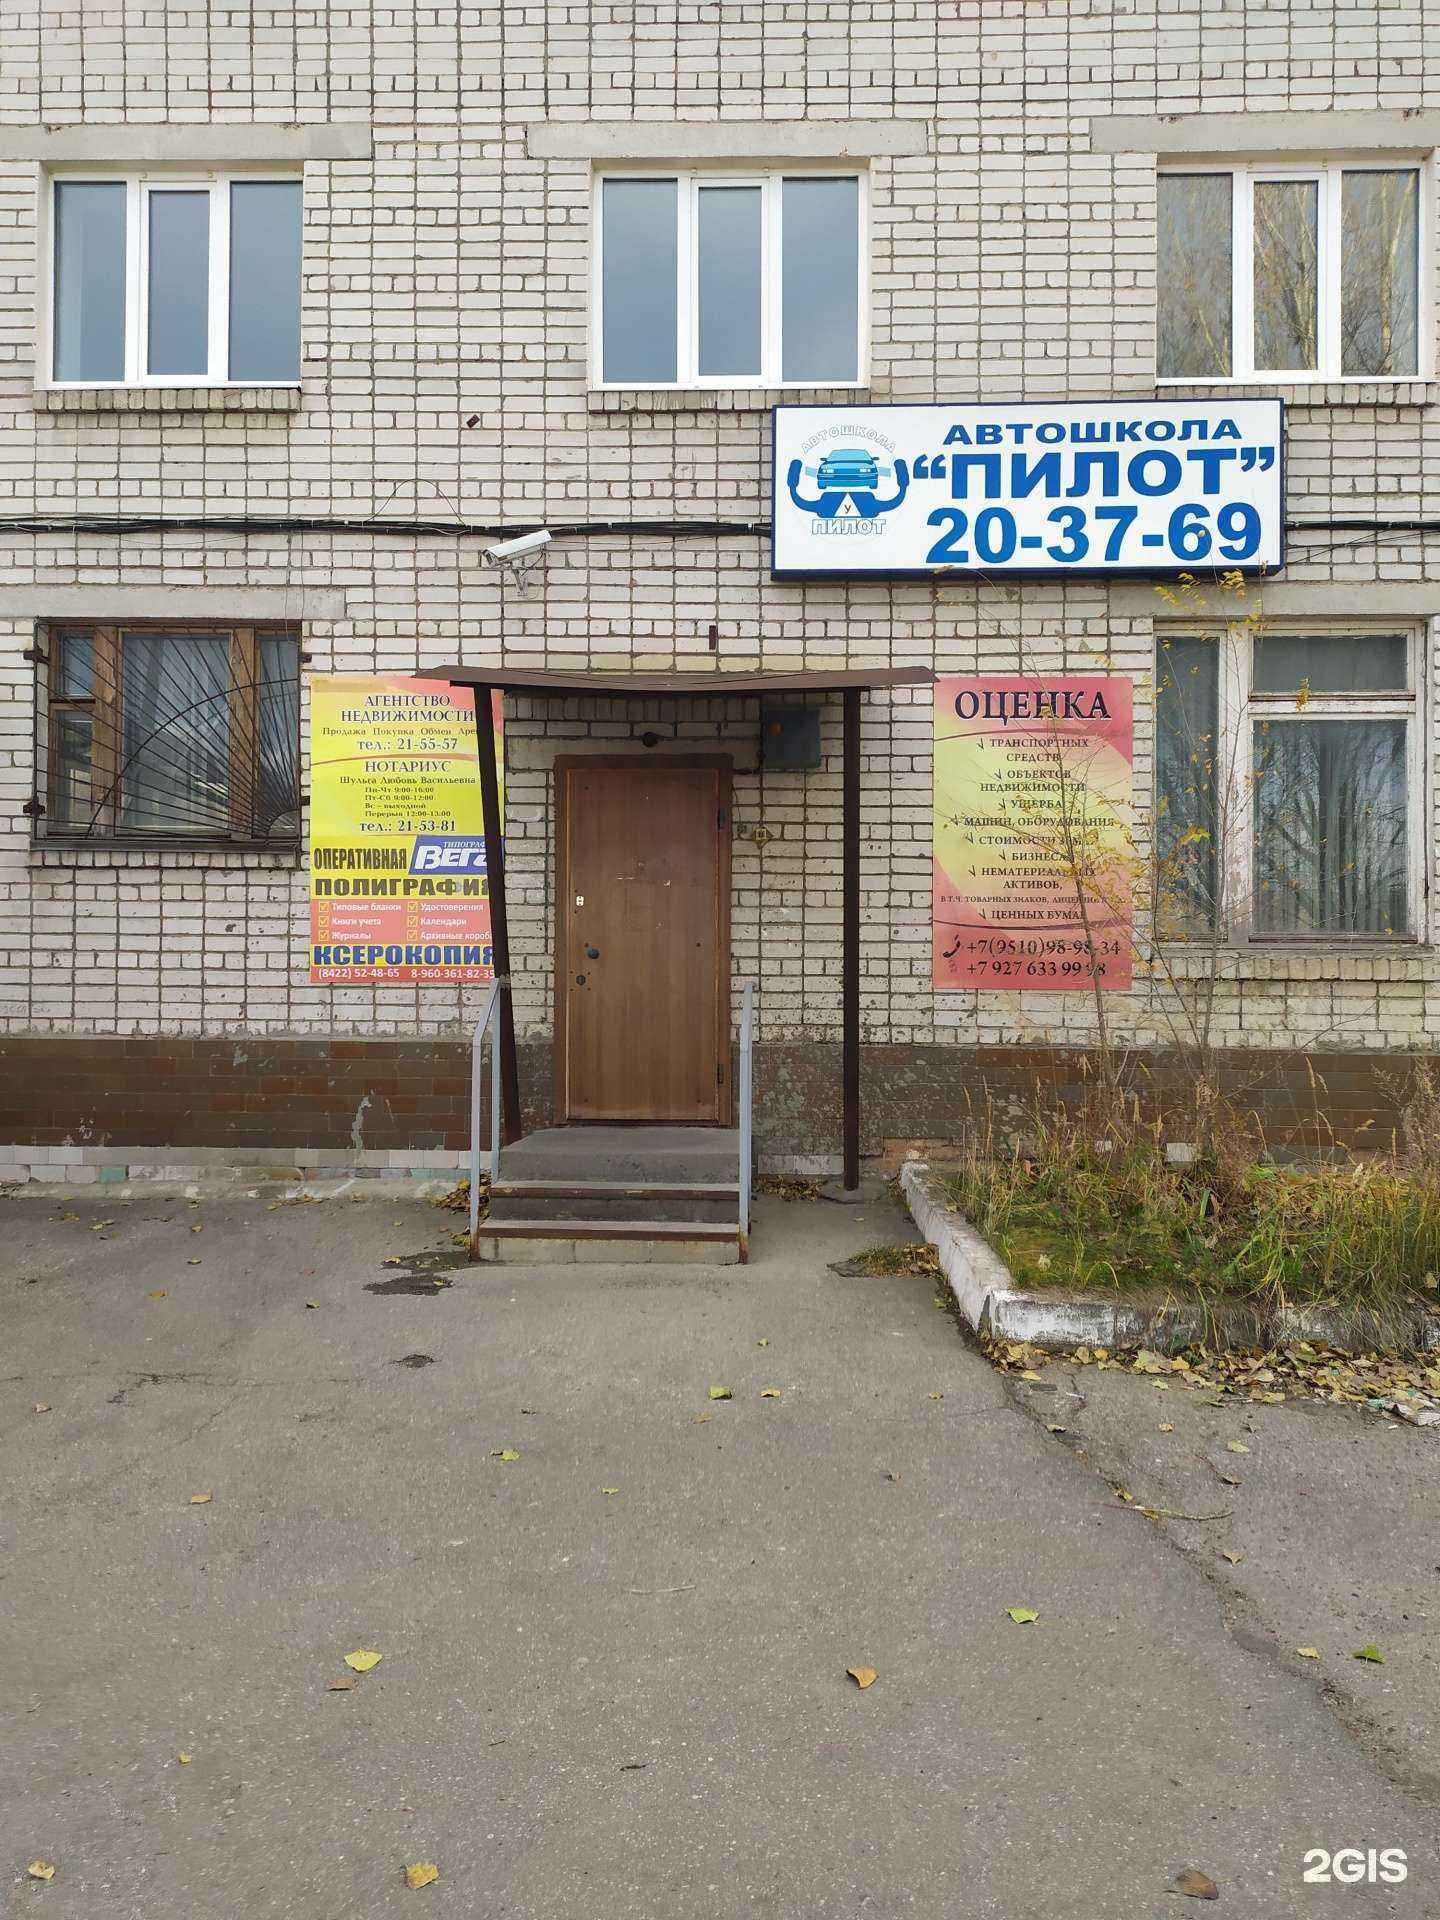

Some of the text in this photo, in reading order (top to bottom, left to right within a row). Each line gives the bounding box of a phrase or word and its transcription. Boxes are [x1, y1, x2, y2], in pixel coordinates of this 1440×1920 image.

[943, 418, 1242, 446] АВТОШКОЛА
[801, 424, 896, 454] АВТОШКОЛА
[811, 519, 887, 535] ПИЛОТ
[925, 501, 1262, 564] 20-37-69
[365, 695, 451, 707] АГЕНТСТВО
[955, 690, 1112, 726] ОЦЕНКА
[341, 710, 474, 724] НЕДВИЖИМОСТИ
[322, 727, 366, 736] Продажа
[373, 727, 414, 737] Покупка
[420, 727, 451, 736] Обмен
[397, 737, 458, 751] 21-55-57
[989, 738, 1089, 748] ТРАНСПОРТНЫХ
[1006, 753, 1061, 763] СРЕДСТВ
[365, 761, 452, 773] НОТАРИУС
[1007, 770, 1071, 779] ОБЪЕКТОВ
[398, 820, 457, 832] 21-53-81
[314, 848, 407, 870] ОПЕРАТИВНАЯ
[332, 902, 401, 911] Типовые бланки
[420, 902, 484, 912] Удостоверения
[991, 911, 1087, 921] ЦЕННЫХ БУМА
[359, 918, 382, 928] учета
[420, 917, 467, 927] Календари
[332, 931, 372, 941] Журналы
[420, 931, 463, 941] Архивные
[314, 945, 495, 966] КСЕРОКОПИЯ
[318, 968, 400, 979] (8422) 52-48-65
[411, 968, 495, 979] 8-960-361-82-35
